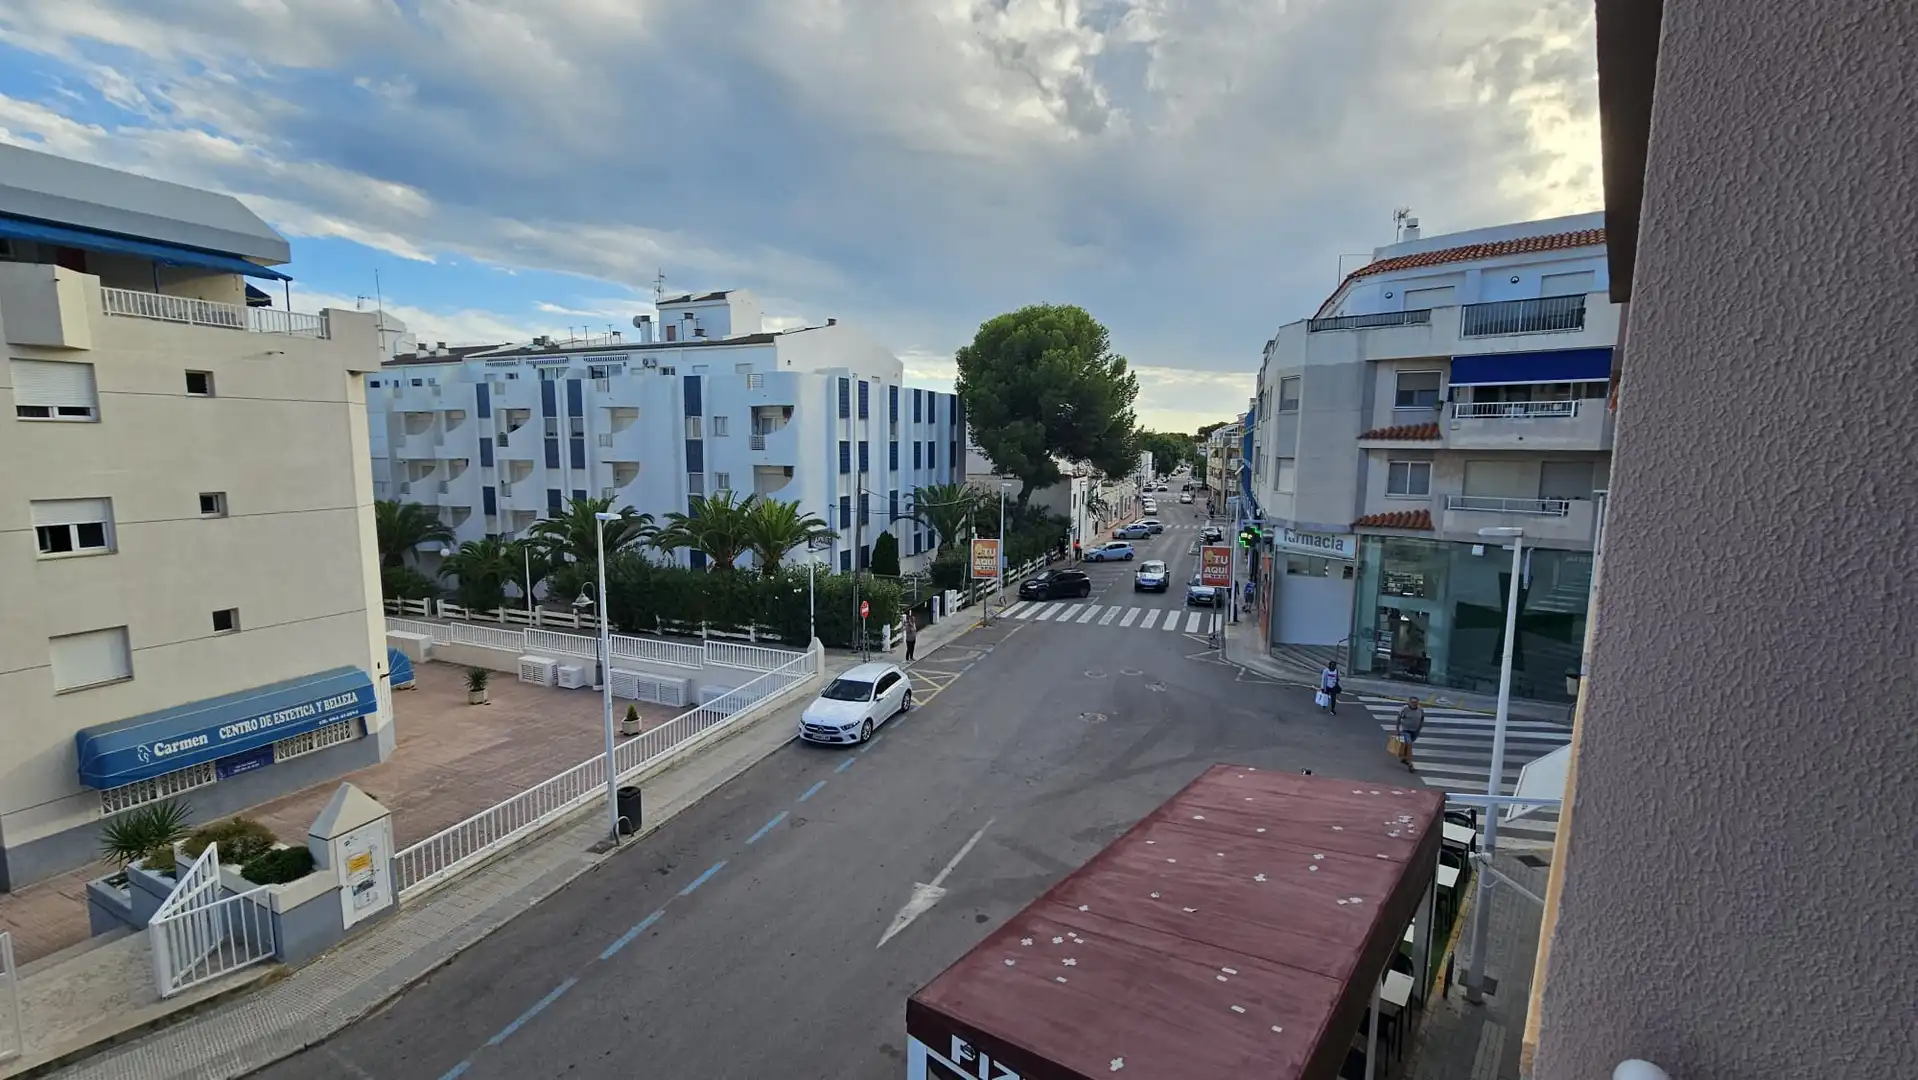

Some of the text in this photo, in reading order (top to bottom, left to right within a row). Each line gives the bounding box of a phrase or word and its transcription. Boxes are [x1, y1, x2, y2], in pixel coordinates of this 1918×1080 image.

[1214, 555, 1228, 565] TU
[153, 734, 209, 757] Carmen
[219, 718, 258, 740] CENTRO
[259, 714, 273, 729] DE
[273, 703, 316, 725] ESTETICA
[315, 701, 323, 713] Y
[323, 692, 358, 711] BELLEZA
[951, 1033, 1026, 1080] PIZ
